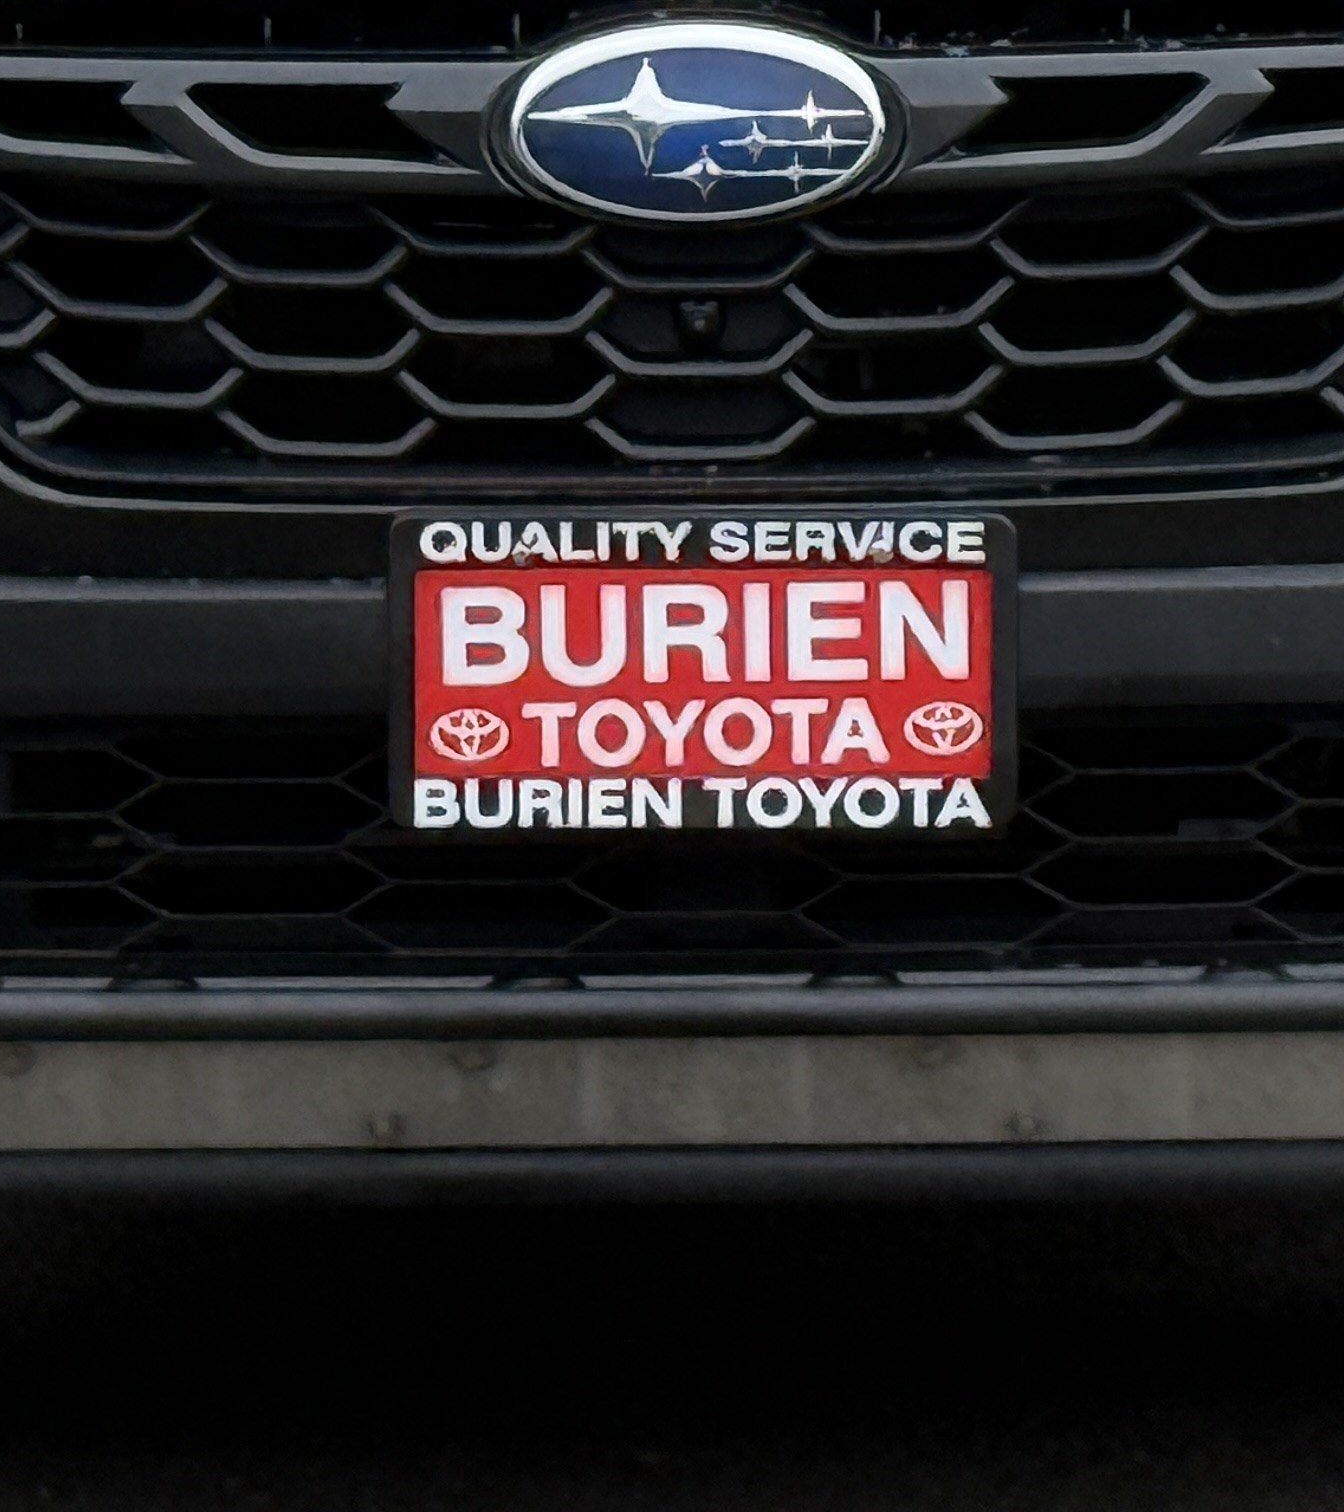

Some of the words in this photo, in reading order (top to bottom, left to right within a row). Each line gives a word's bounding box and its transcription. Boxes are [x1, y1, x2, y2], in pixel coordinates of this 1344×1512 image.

[419, 521, 693, 563] QUALITY
[709, 521, 987, 564] SERVICE
[440, 579, 970, 687] BURIEN
[522, 697, 892, 769] TOYOTA
[413, 778, 683, 829] BURIEN
[701, 778, 994, 829] TOYOTA
